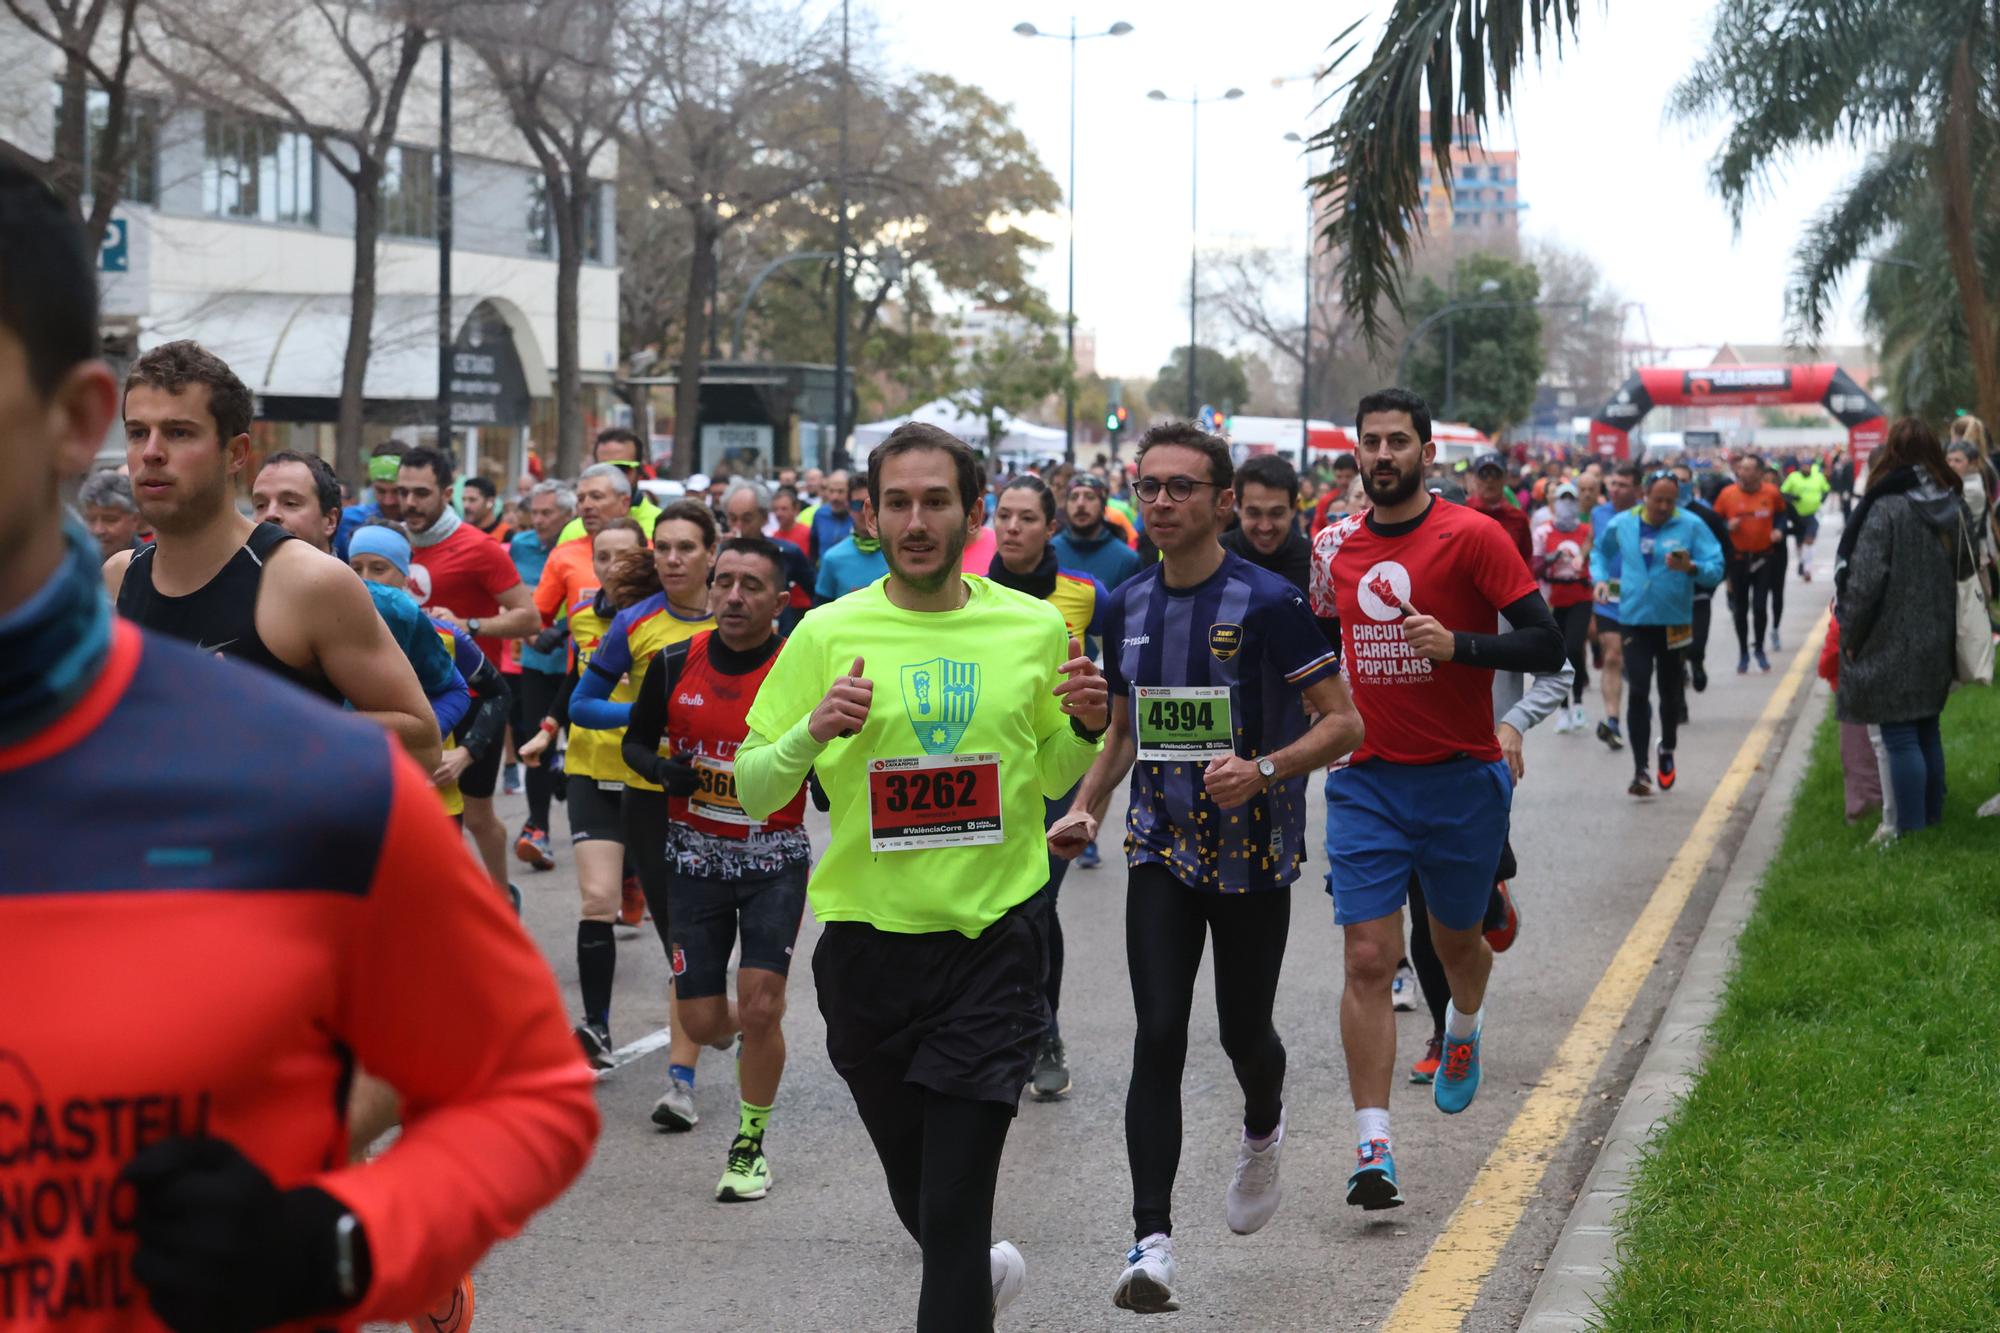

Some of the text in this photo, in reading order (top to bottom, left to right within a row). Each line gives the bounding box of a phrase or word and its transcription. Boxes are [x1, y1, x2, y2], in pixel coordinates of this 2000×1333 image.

[1352, 624, 1406, 641] CIRCUIT
[1356, 658, 1432, 676] POPULARS
[1359, 676, 1381, 685] CIUTAT
[1382, 677, 1393, 685] DE
[1148, 701, 1214, 731] 4394
[886, 770, 977, 813] 3262
[903, 824, 962, 835] #ValènciaCorre
